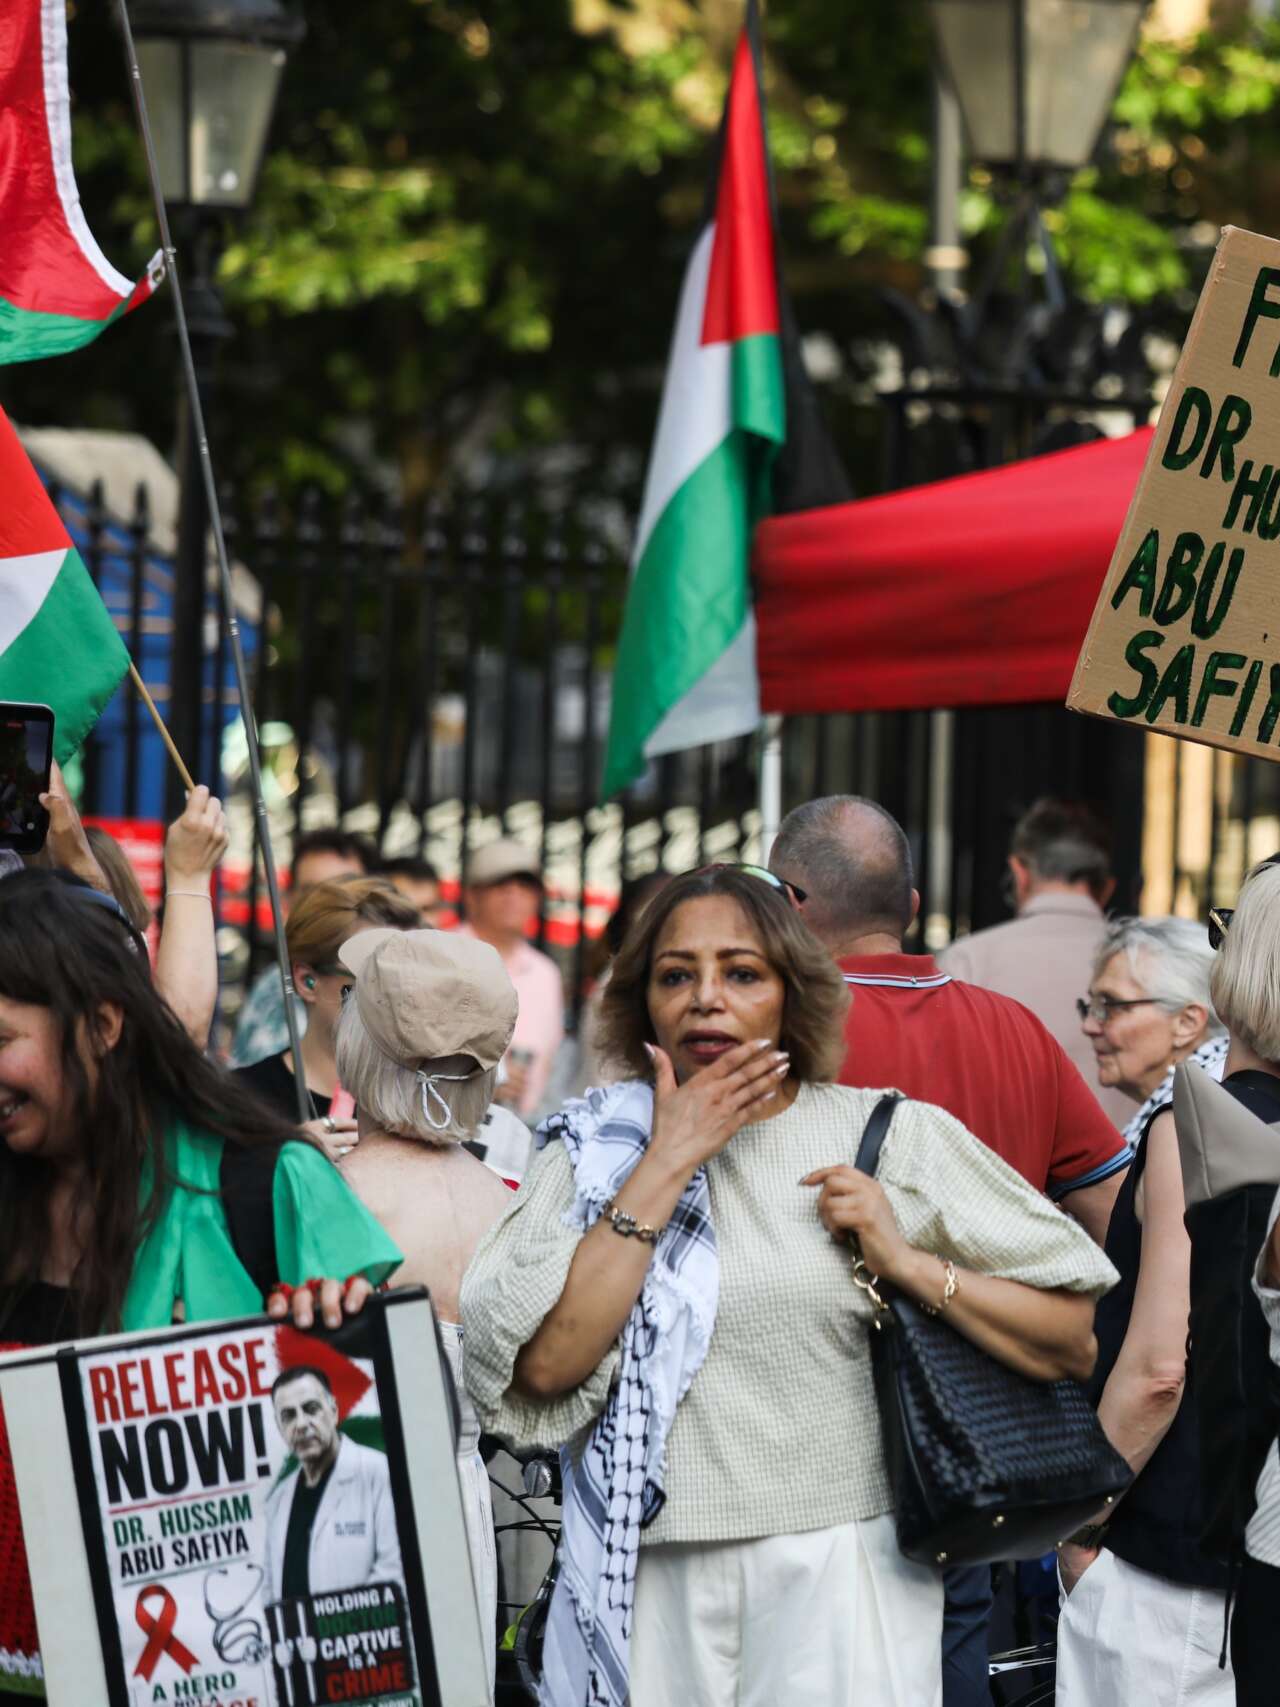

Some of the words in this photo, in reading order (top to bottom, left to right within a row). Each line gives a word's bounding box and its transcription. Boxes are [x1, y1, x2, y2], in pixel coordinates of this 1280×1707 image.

[1161, 386, 1252, 482] DR
[1111, 527, 1245, 640] ABU
[89, 1339, 273, 1424] RELEASE
[98, 1403, 271, 1504] NOW!
[113, 1516, 152, 1547] DR.
[158, 1494, 253, 1537] HUSSAM
[121, 1544, 165, 1578] ABU
[171, 1526, 249, 1566] SAFIYA
[314, 1589, 380, 1616] HOLDING
[383, 1587, 395, 1604] A
[320, 1626, 402, 1661] CAPTIVE
[152, 1683, 167, 1702] A
[174, 1670, 236, 1697] HERO
[326, 1662, 408, 1700] CRIME
